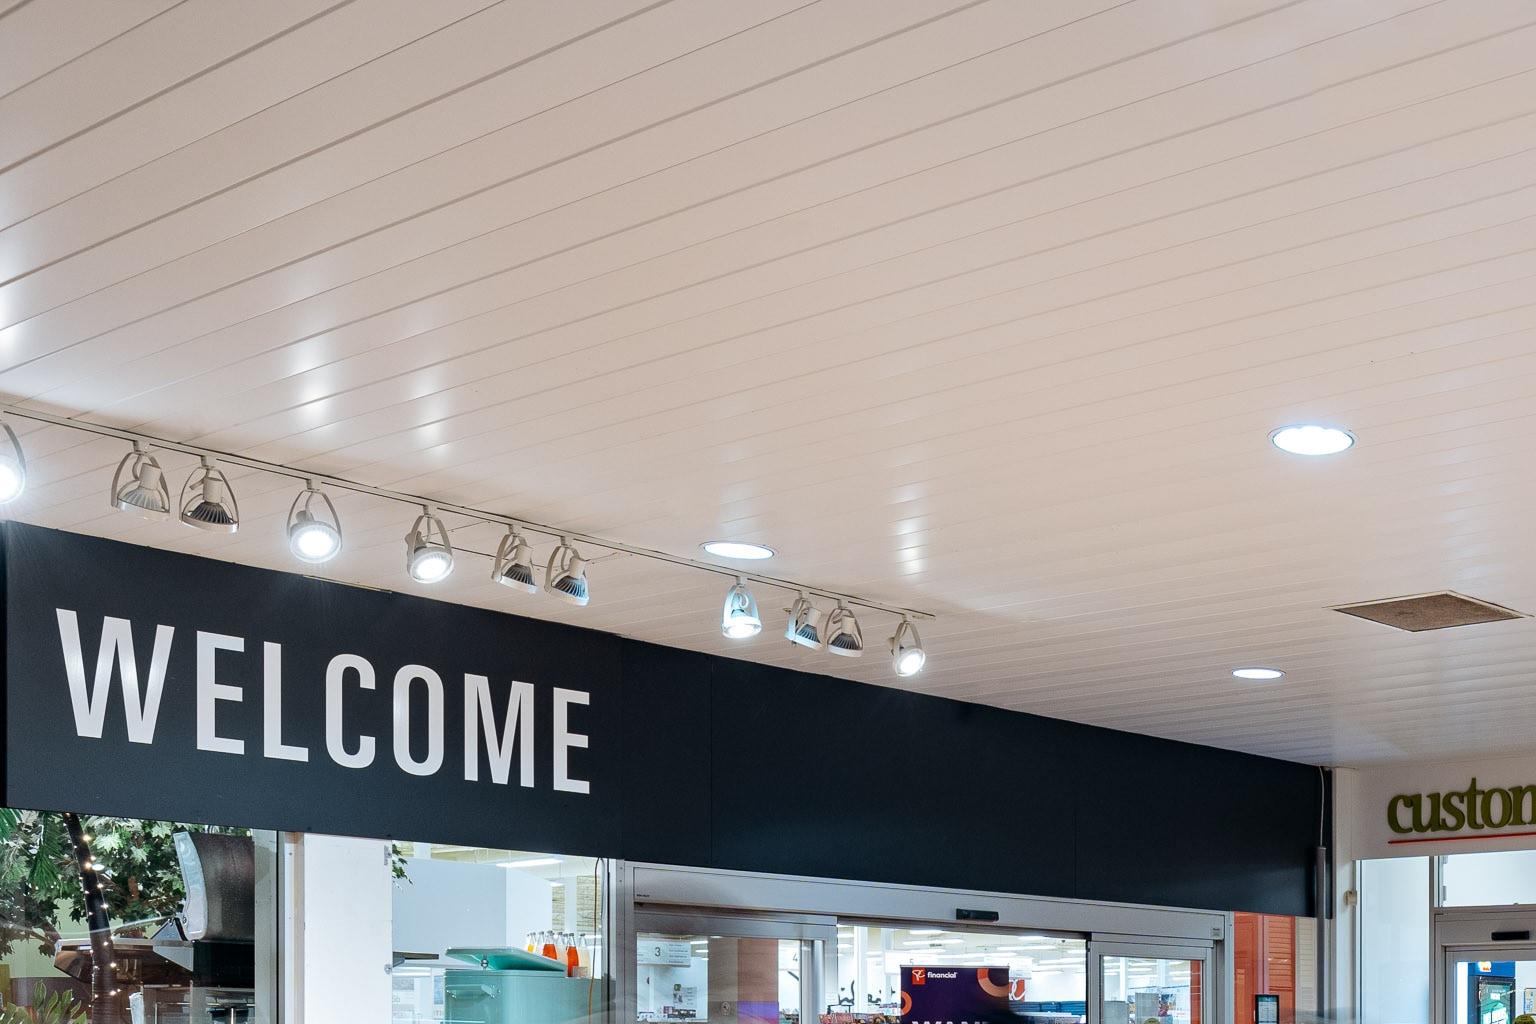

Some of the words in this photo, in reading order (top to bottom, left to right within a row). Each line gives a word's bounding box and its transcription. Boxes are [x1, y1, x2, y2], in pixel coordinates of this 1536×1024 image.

[56, 608, 590, 794] WELCOME
[654, 946, 661, 957] 3
[927, 971, 958, 979] financial
